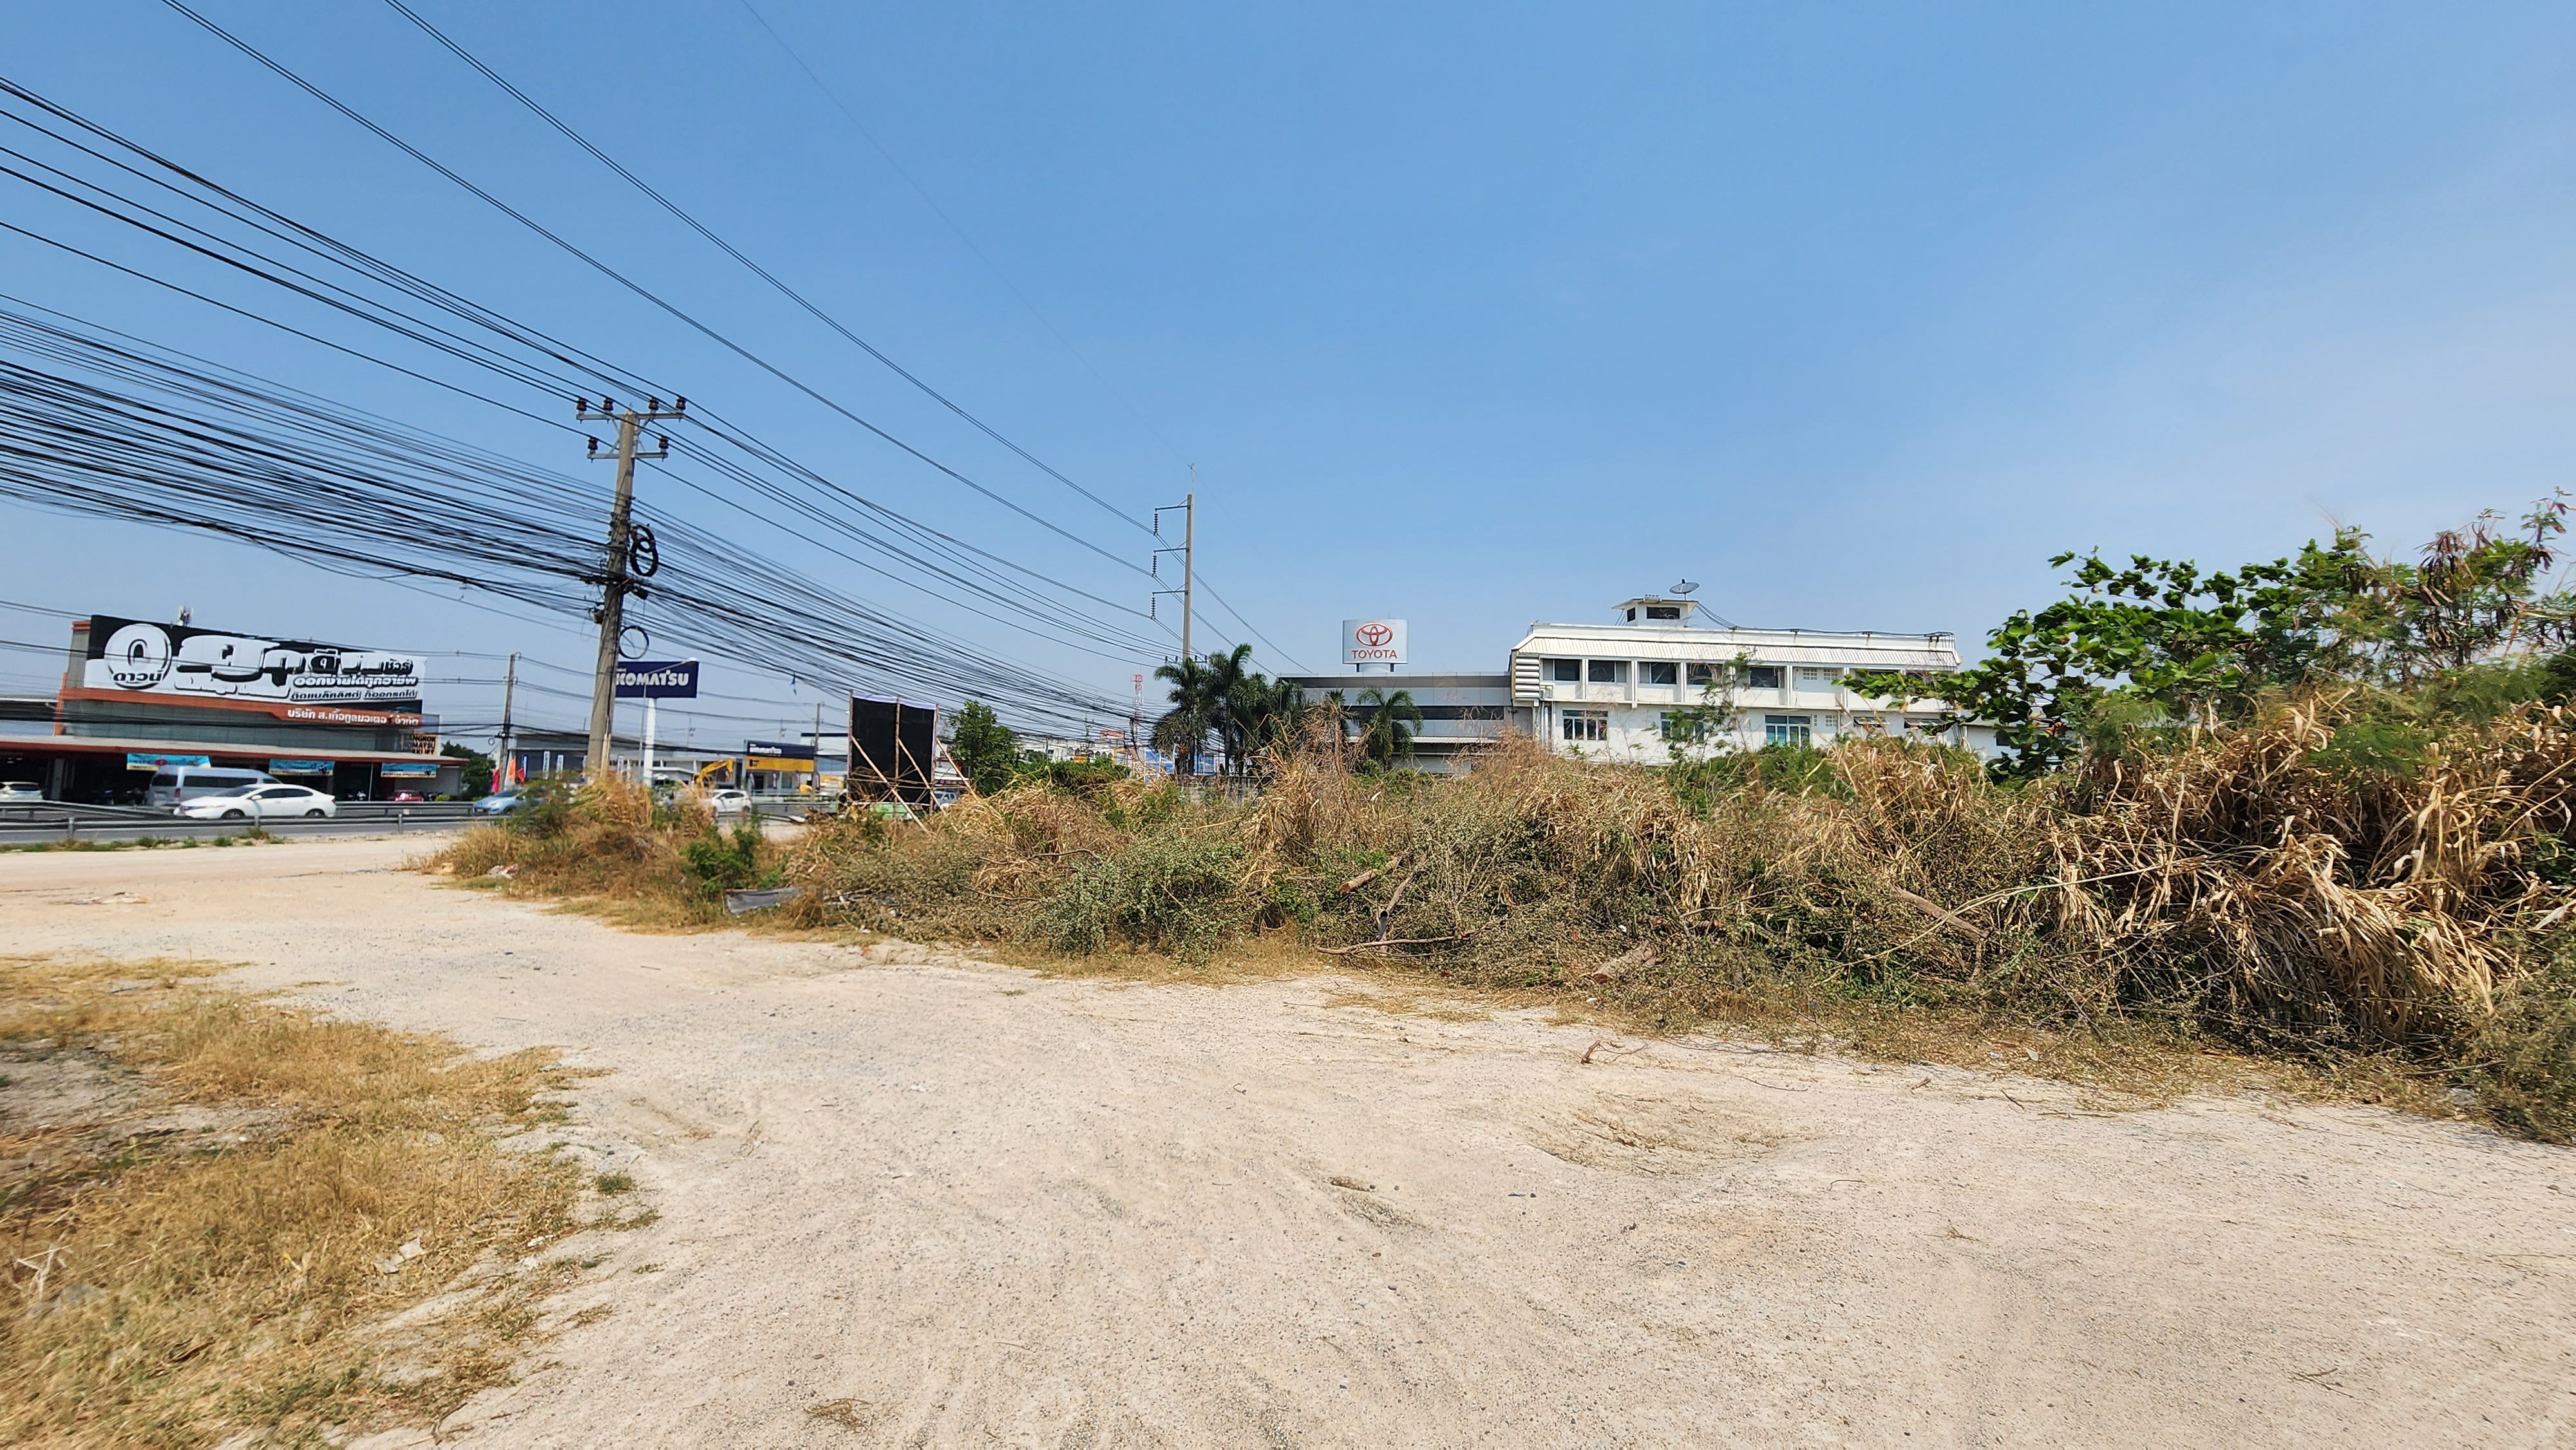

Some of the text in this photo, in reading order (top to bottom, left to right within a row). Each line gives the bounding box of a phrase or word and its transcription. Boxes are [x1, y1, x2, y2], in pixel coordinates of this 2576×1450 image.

[1351, 649, 1397, 659] TOYOTA
[113, 670, 163, 682] ดาวน์
[616, 670, 689, 686] KOMATSU
[287, 708, 316, 719] บริษัท
[395, 715, 419, 726] จำกัด
